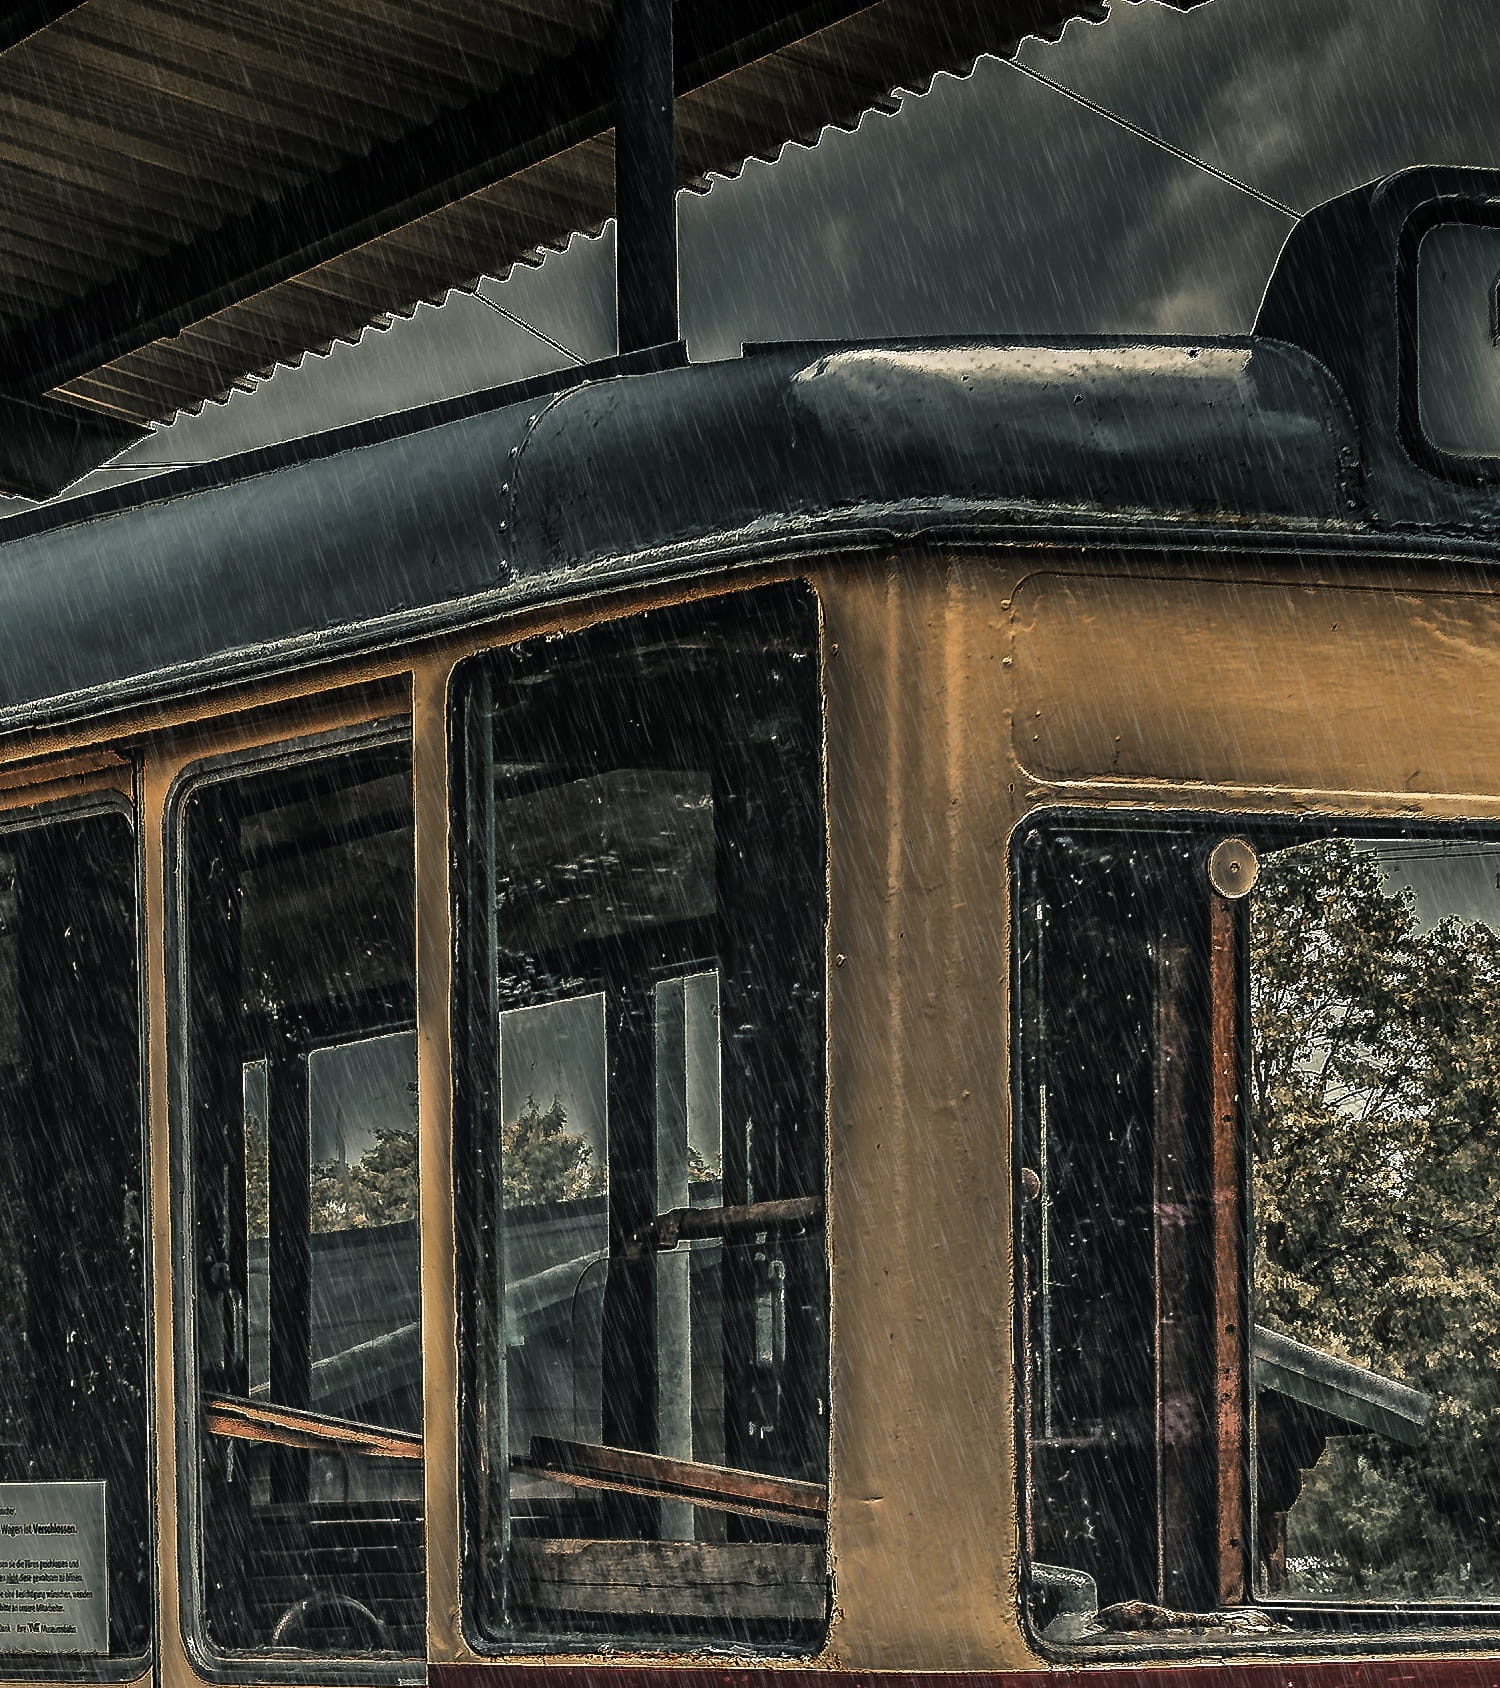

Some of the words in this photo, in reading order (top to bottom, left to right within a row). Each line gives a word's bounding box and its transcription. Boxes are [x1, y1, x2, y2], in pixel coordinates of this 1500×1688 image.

[1, 1523, 23, 1538] Wagen
[23, 1523, 33, 1534] ist
[33, 1522, 78, 1535] Verschlossen.
